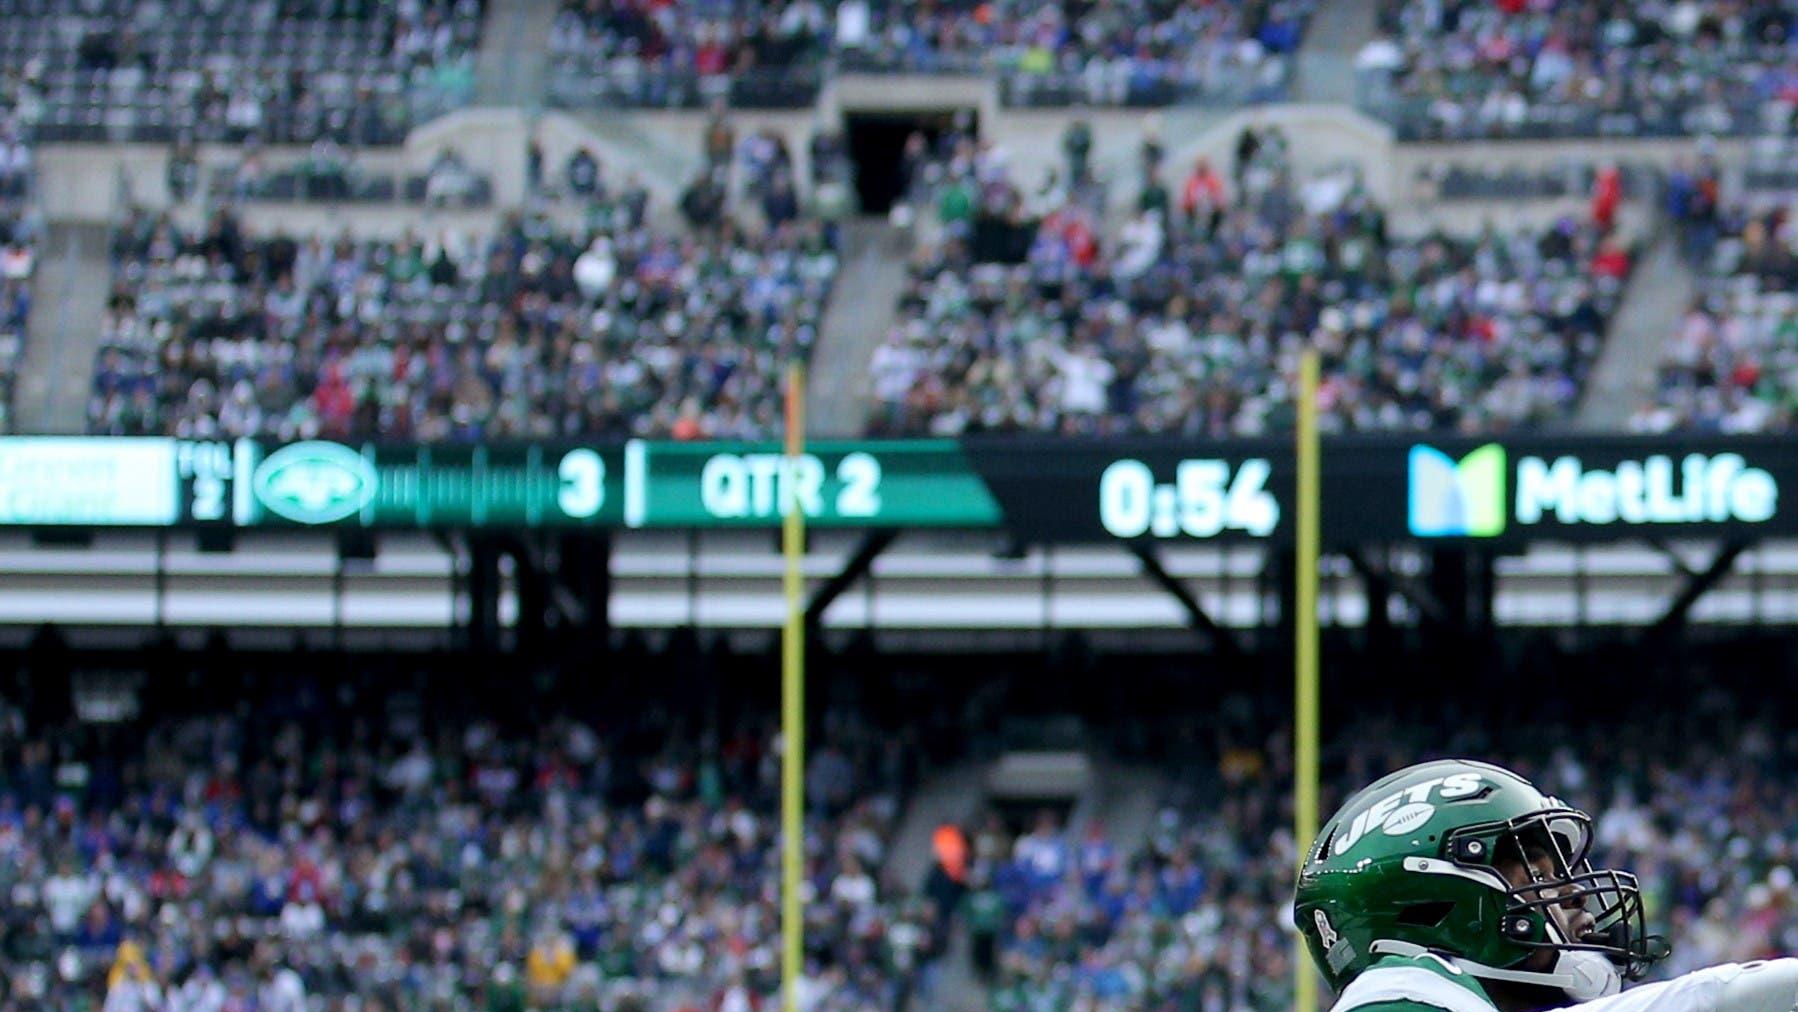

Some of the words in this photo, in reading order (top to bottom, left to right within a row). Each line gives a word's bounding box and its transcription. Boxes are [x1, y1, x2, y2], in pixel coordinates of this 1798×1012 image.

[191, 479, 224, 520] 2
[558, 448, 606, 518] 3
[701, 453, 825, 517] QTR
[835, 452, 882, 517] 2
[1100, 458, 1279, 538] 0:54
[1515, 452, 1778, 525] MetLife
[1334, 772, 1482, 856] JETS
